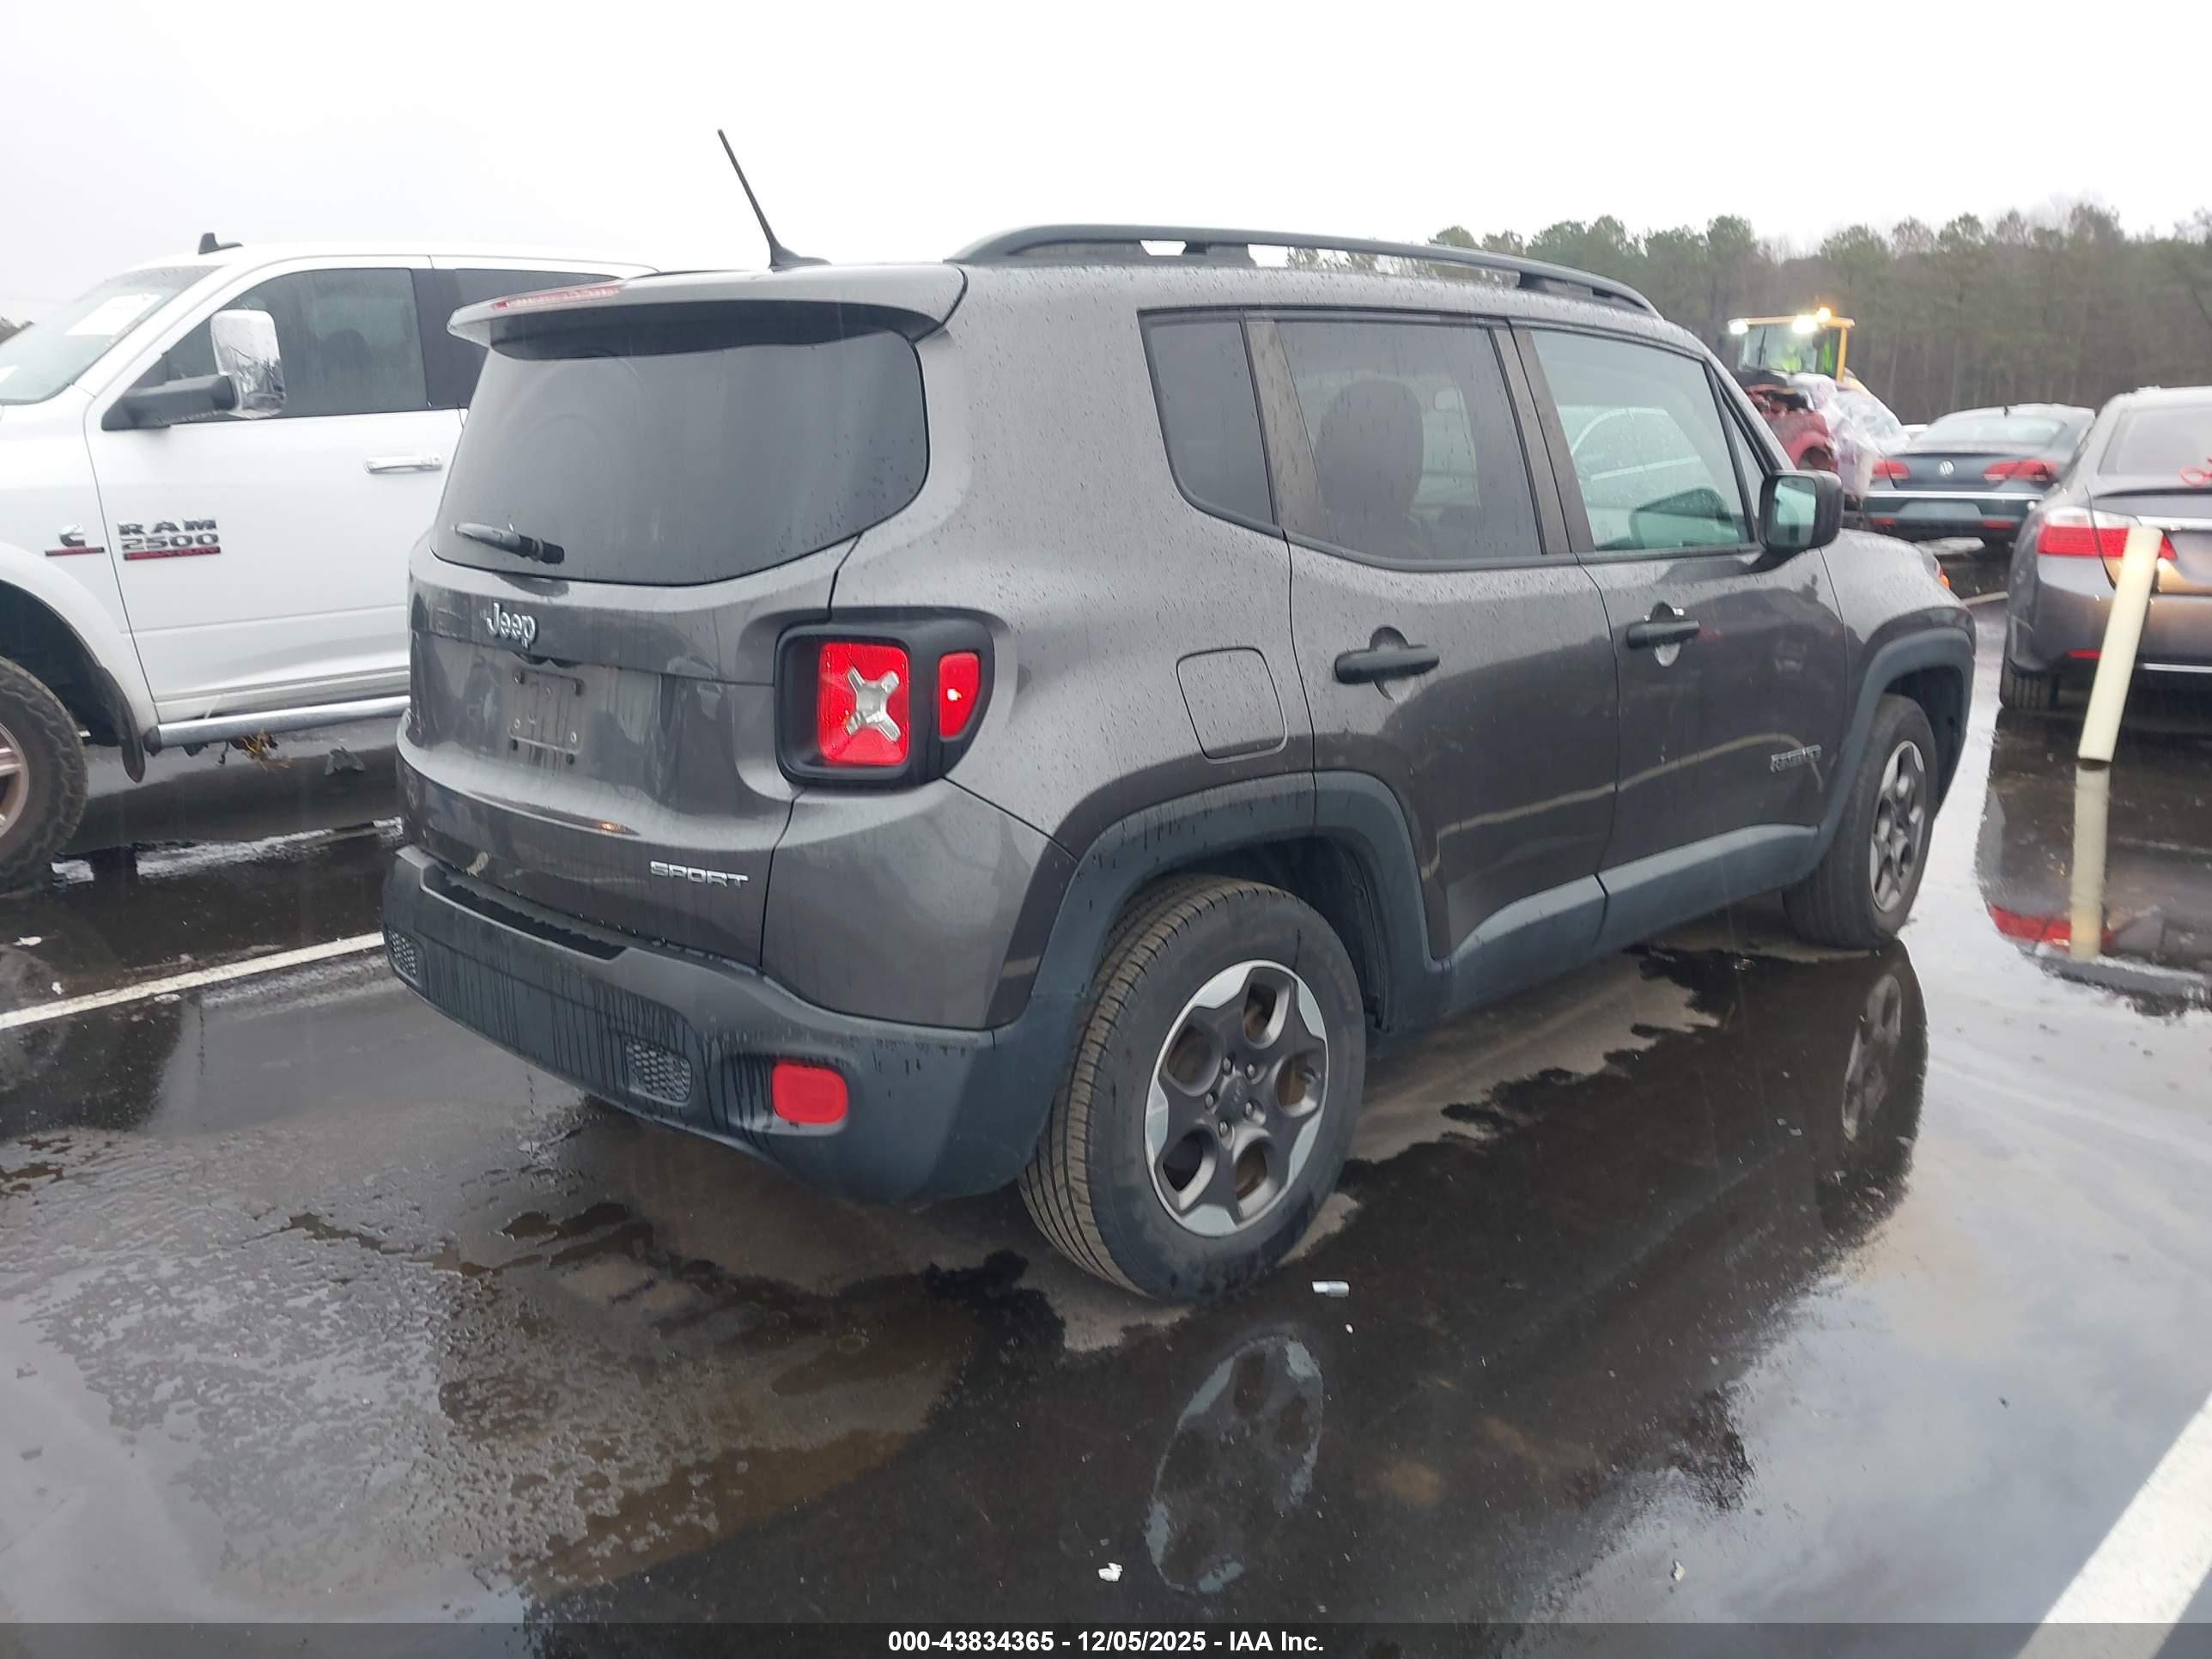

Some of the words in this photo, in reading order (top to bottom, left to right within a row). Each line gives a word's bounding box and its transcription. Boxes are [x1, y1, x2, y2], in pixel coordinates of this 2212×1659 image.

[118, 519, 218, 535] RAM
[121, 533, 219, 551] 2500
[486, 602, 536, 648] Jeep
[650, 860, 749, 887] SPORT
